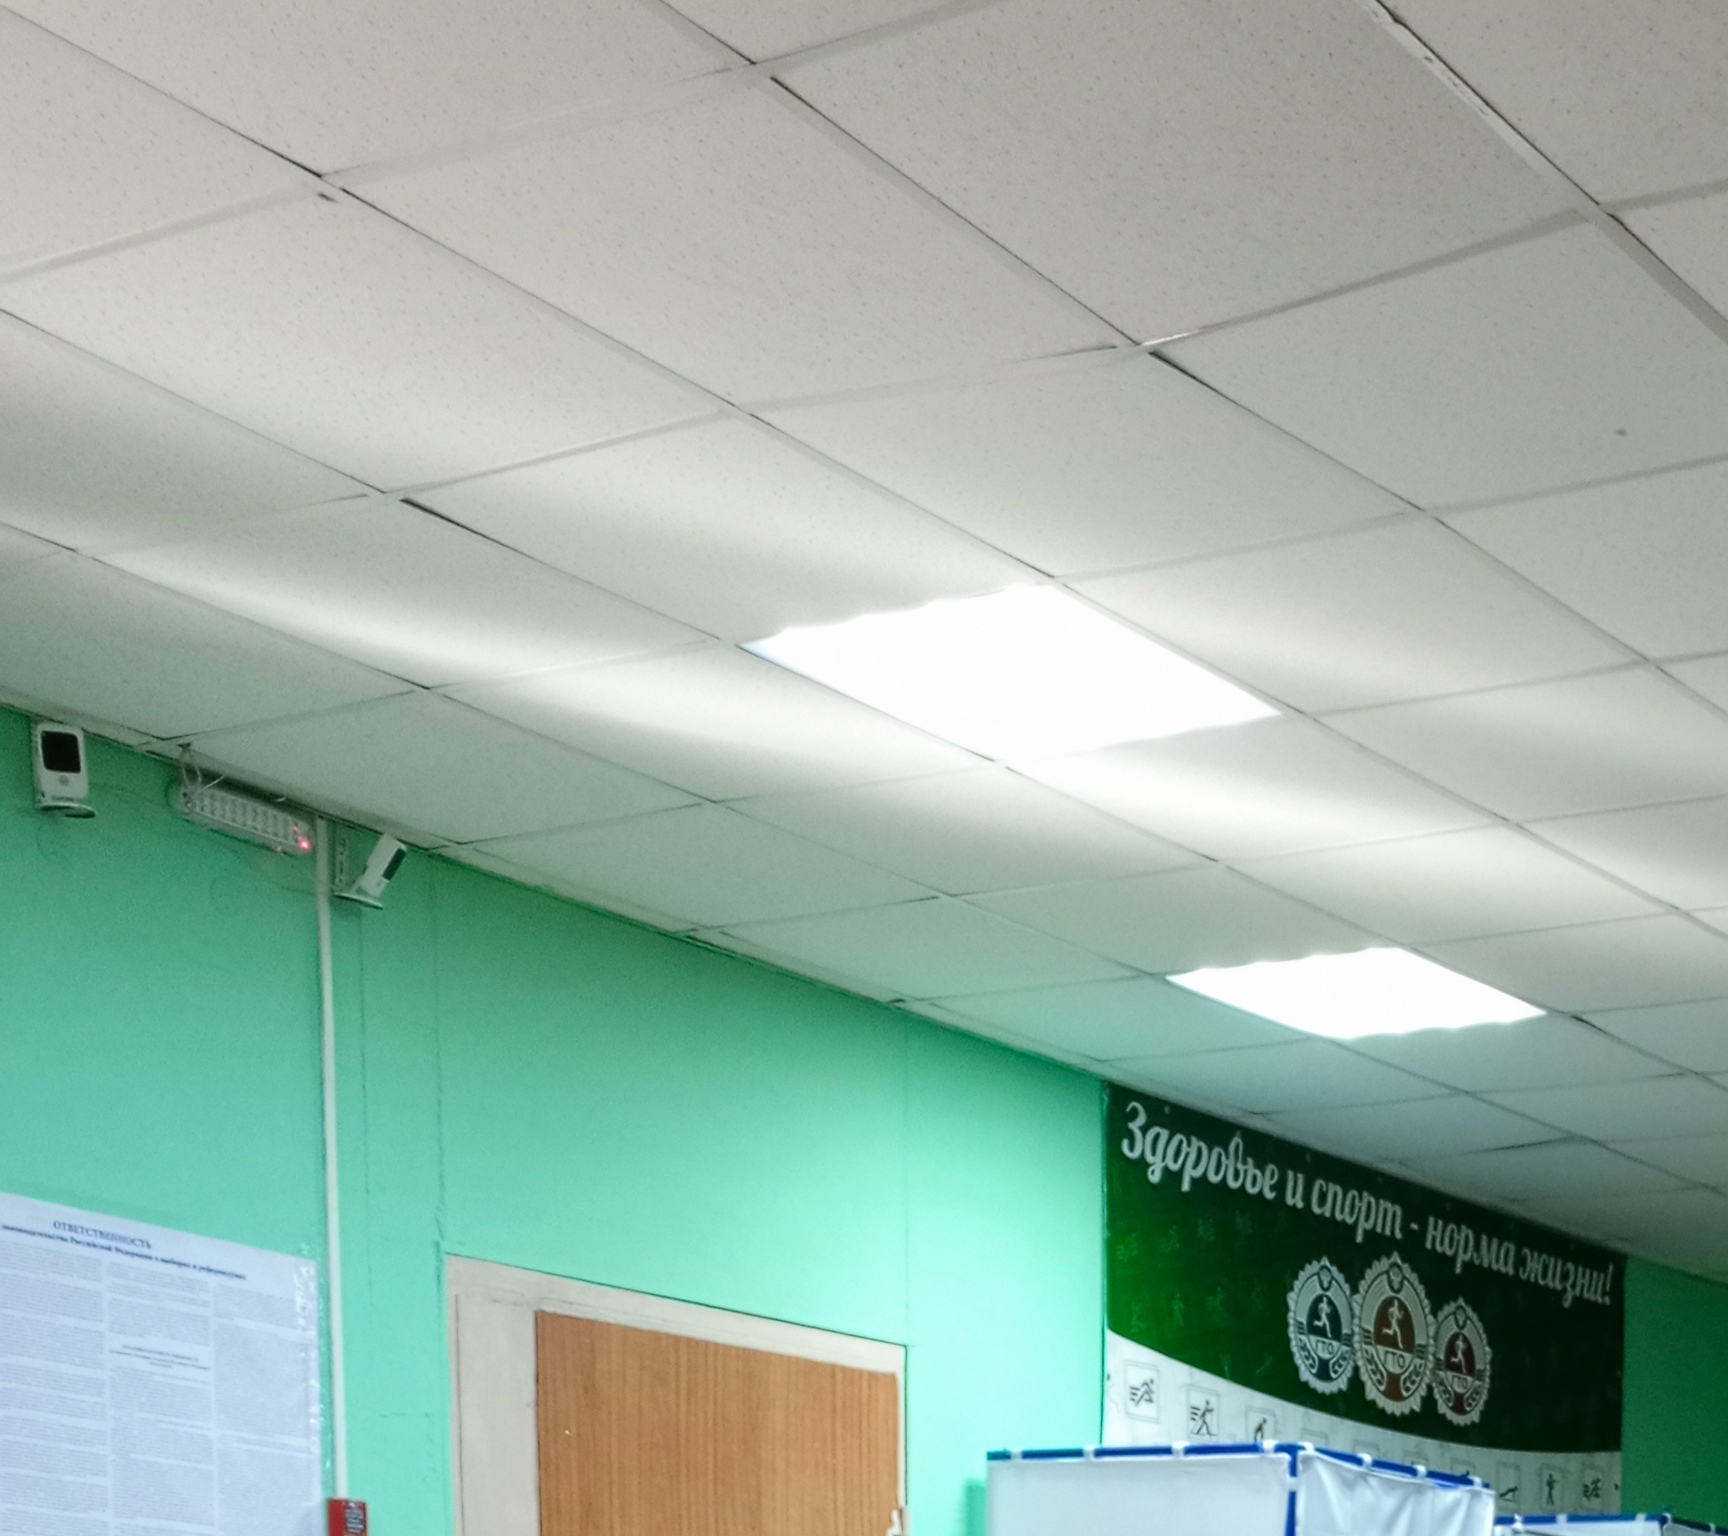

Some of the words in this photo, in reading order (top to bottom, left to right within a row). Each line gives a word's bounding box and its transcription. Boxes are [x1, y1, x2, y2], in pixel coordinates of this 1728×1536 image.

[1121, 1100, 1279, 1200] Здоровье
[1285, 1170, 1304, 1209] и
[1310, 1178, 1403, 1243] спорт
[1425, 1215, 1516, 1274] норма
[1518, 1247, 1614, 1309] жизни!
[53, 1219, 152, 1250] ОТВЕТСТВЕННОСТЬ
[1384, 1350, 1406, 1369] ГТО
